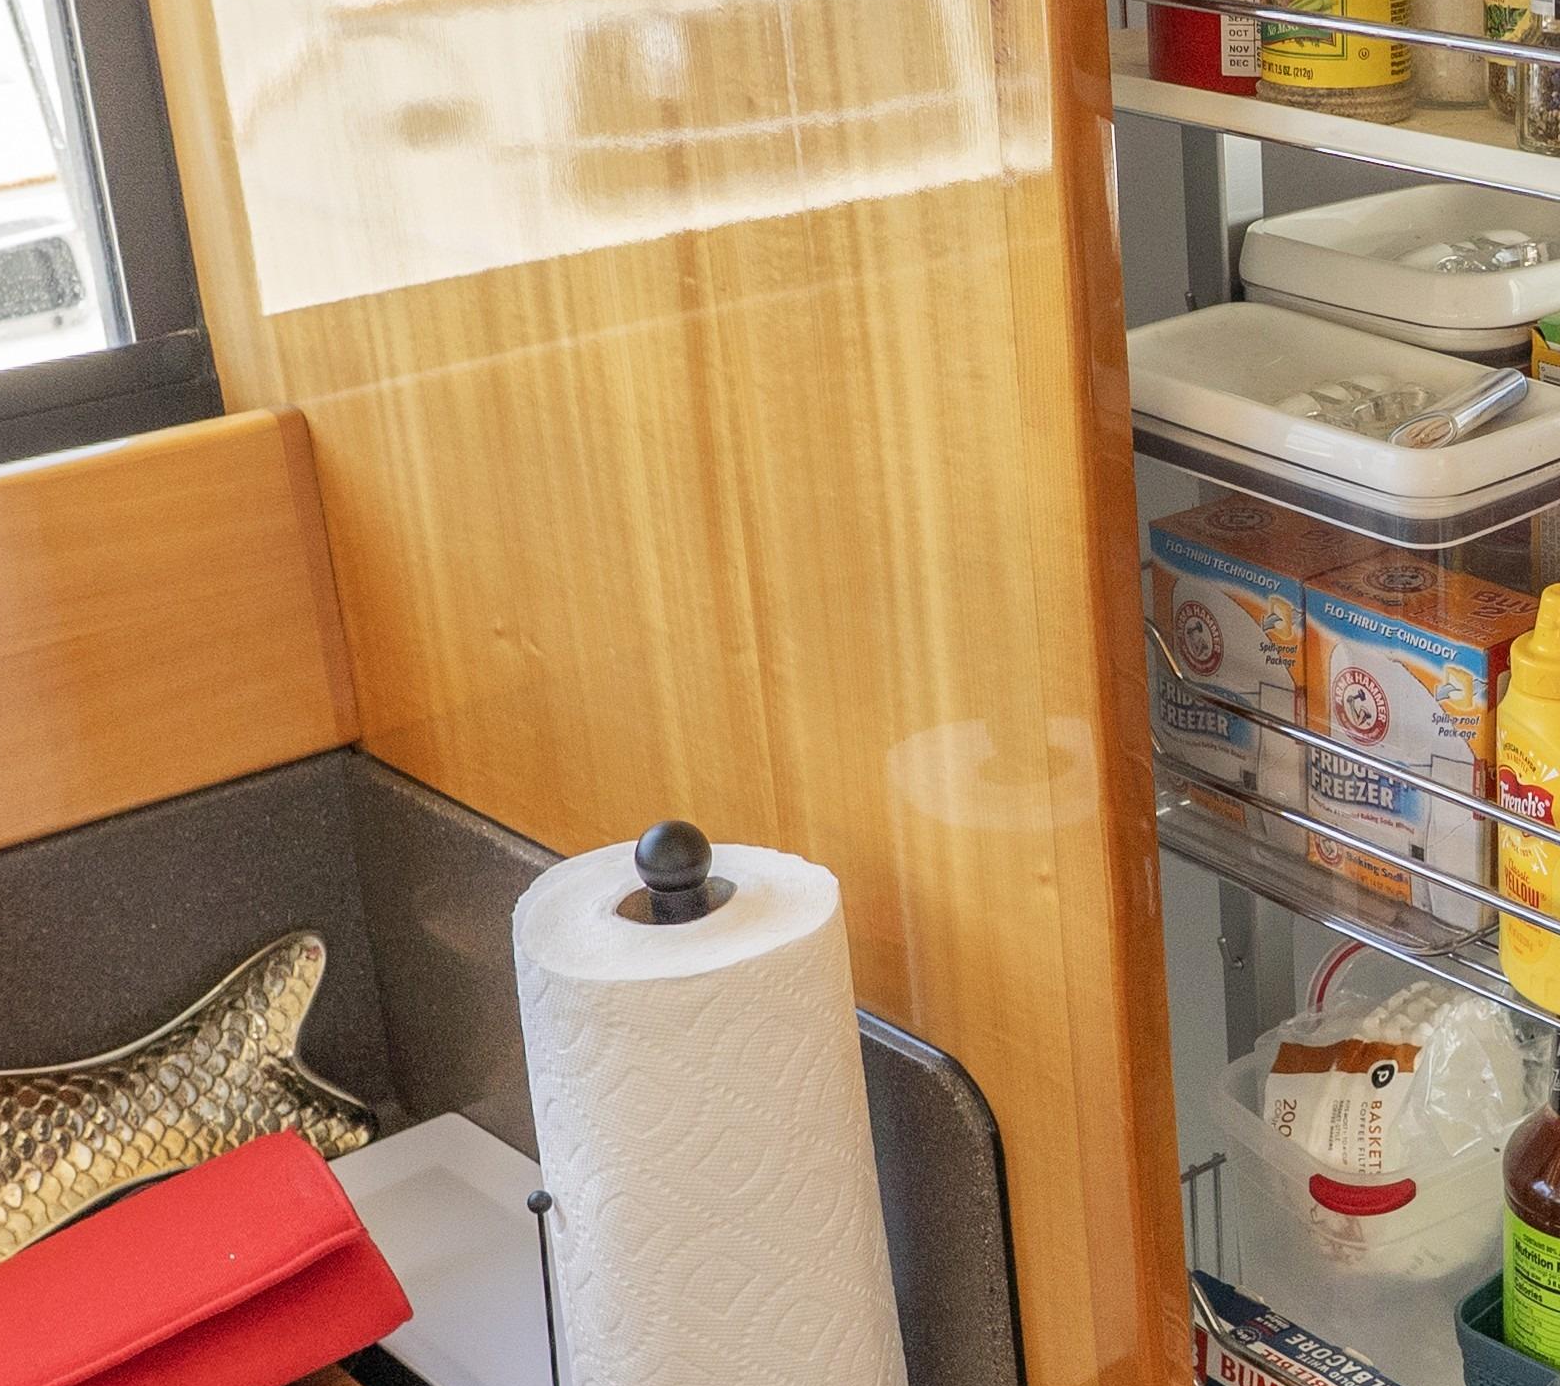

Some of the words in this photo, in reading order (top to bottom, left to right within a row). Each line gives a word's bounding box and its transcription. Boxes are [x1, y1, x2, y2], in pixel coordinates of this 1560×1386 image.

[1228, 29, 1249, 38] OCT
[1229, 45, 1250, 54] NOV
[1229, 59, 1249, 68] DEC
[1165, 539, 1211, 566] FLO-THRU
[1212, 558, 1280, 591] TECHNOLOGY
[1259, 641, 1298, 655] Spill-proof
[1324, 602, 1378, 633] FLO-THRU
[1380, 621, 1457, 661] TECHNOLOGY
[1265, 656, 1296, 667] Package
[1335, 676, 1347, 705] ARM
[1345, 671, 1355, 684] &
[1354, 674, 1387, 722] HAMMER
[1160, 699, 1229, 739] FREEZER
[1311, 767, 1394, 811] FREEZER
[1499, 781, 1545, 819] French's
[1505, 866, 1540, 909] YELLOW
[1278, 1099, 1297, 1138] 200
[1368, 1100, 1382, 1173] BASKET
[1515, 1239, 1553, 1271] Nutrition
